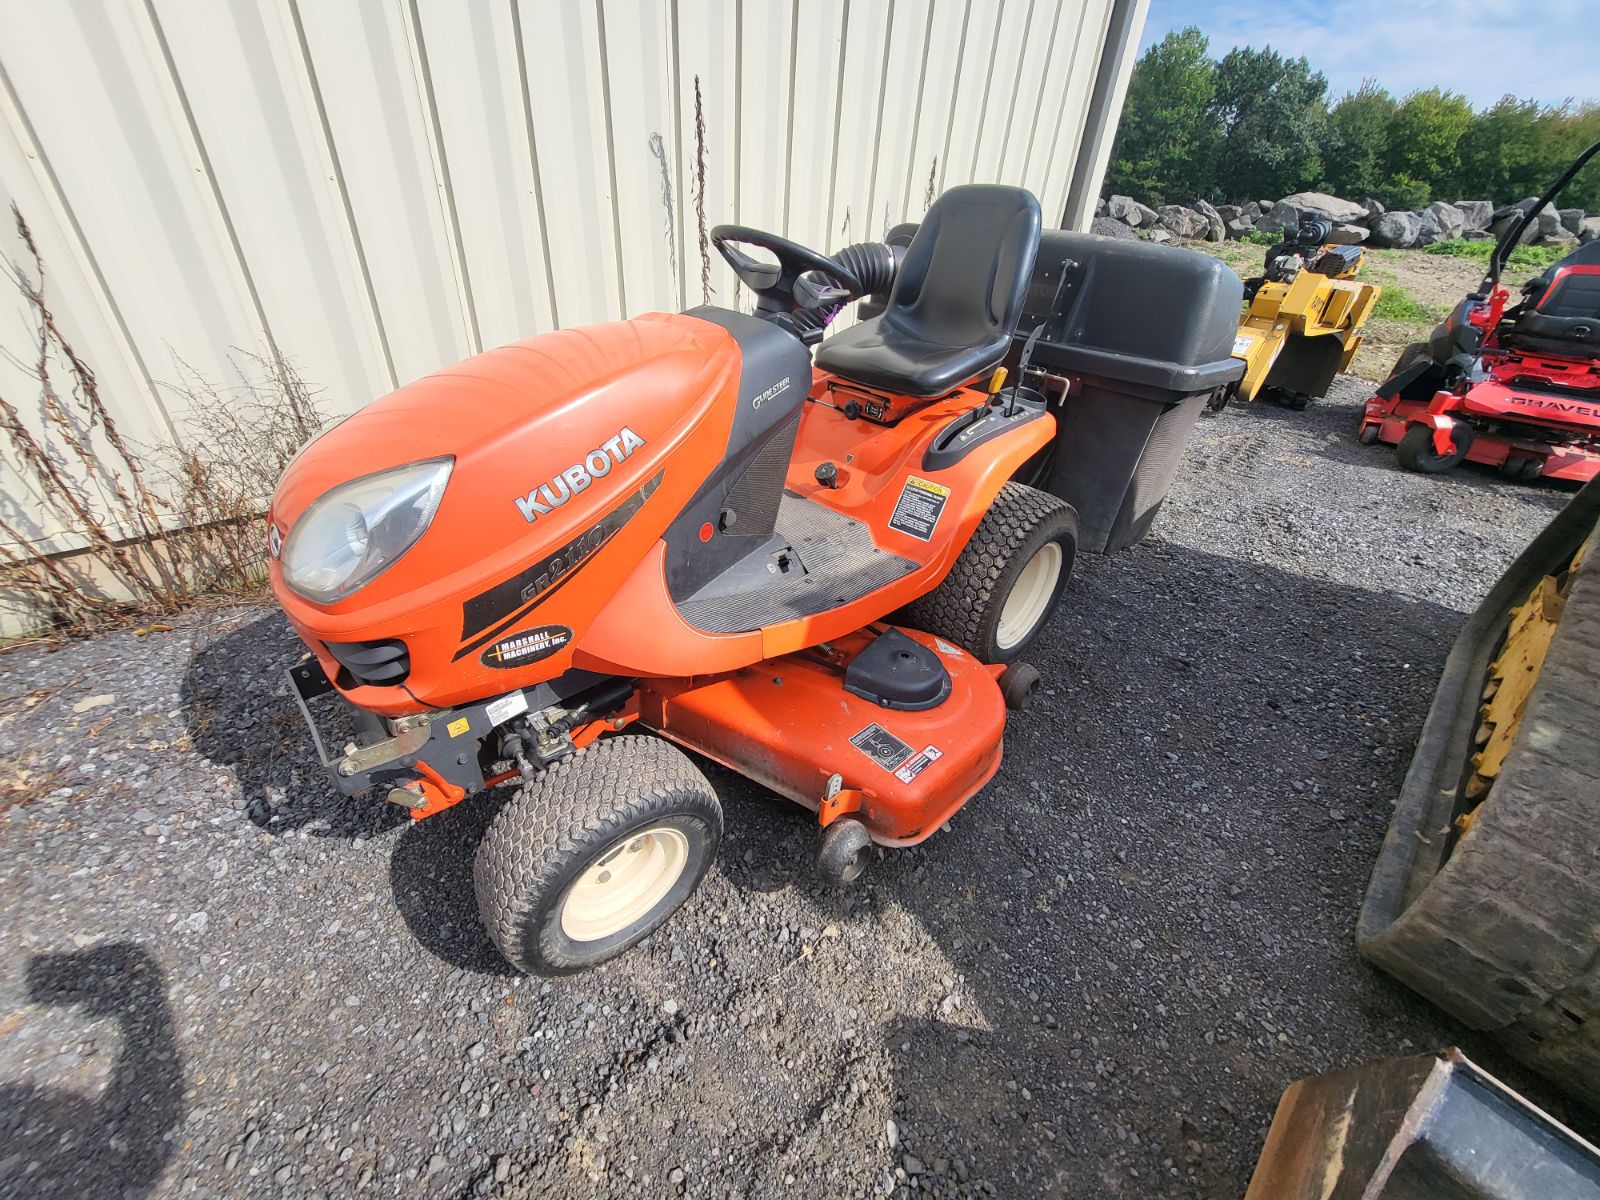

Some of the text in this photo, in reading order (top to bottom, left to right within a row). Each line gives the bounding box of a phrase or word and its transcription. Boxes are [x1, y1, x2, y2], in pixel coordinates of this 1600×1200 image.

[514, 425, 646, 524] KUBOTA
[918, 481, 943, 494] CAUTION
[520, 523, 607, 604] GR2110
[501, 631, 550, 651] MARSHALL
[551, 636, 567, 645] Inc.
